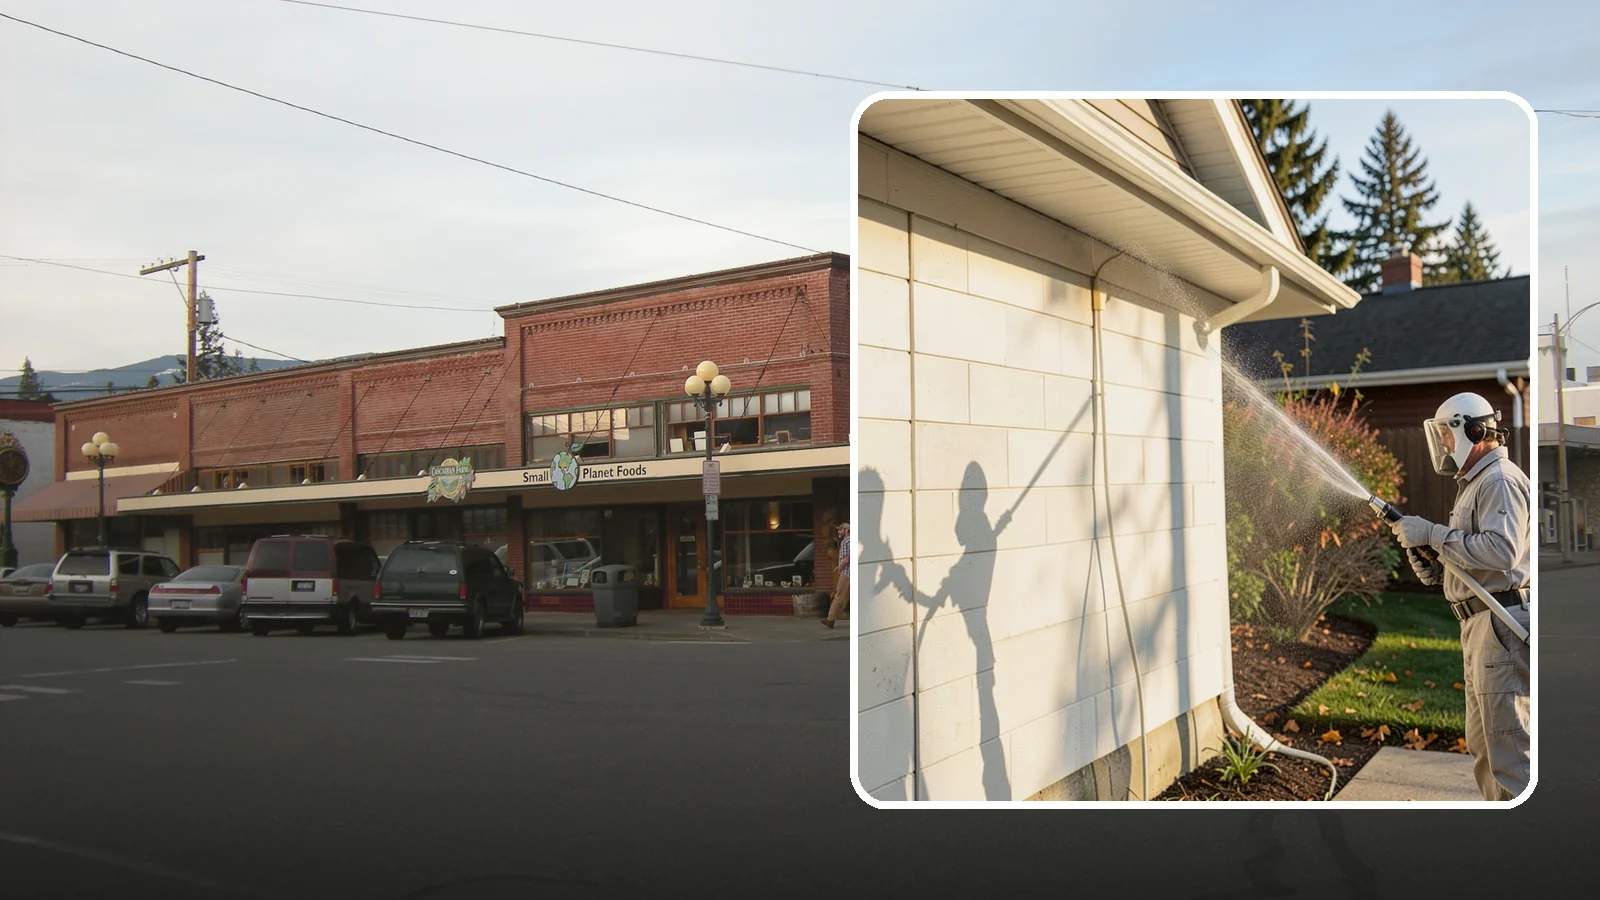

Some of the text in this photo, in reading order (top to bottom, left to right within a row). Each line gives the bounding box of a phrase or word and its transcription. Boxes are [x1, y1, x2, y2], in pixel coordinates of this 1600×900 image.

[523, 464, 647, 483] Small Planet Foods
